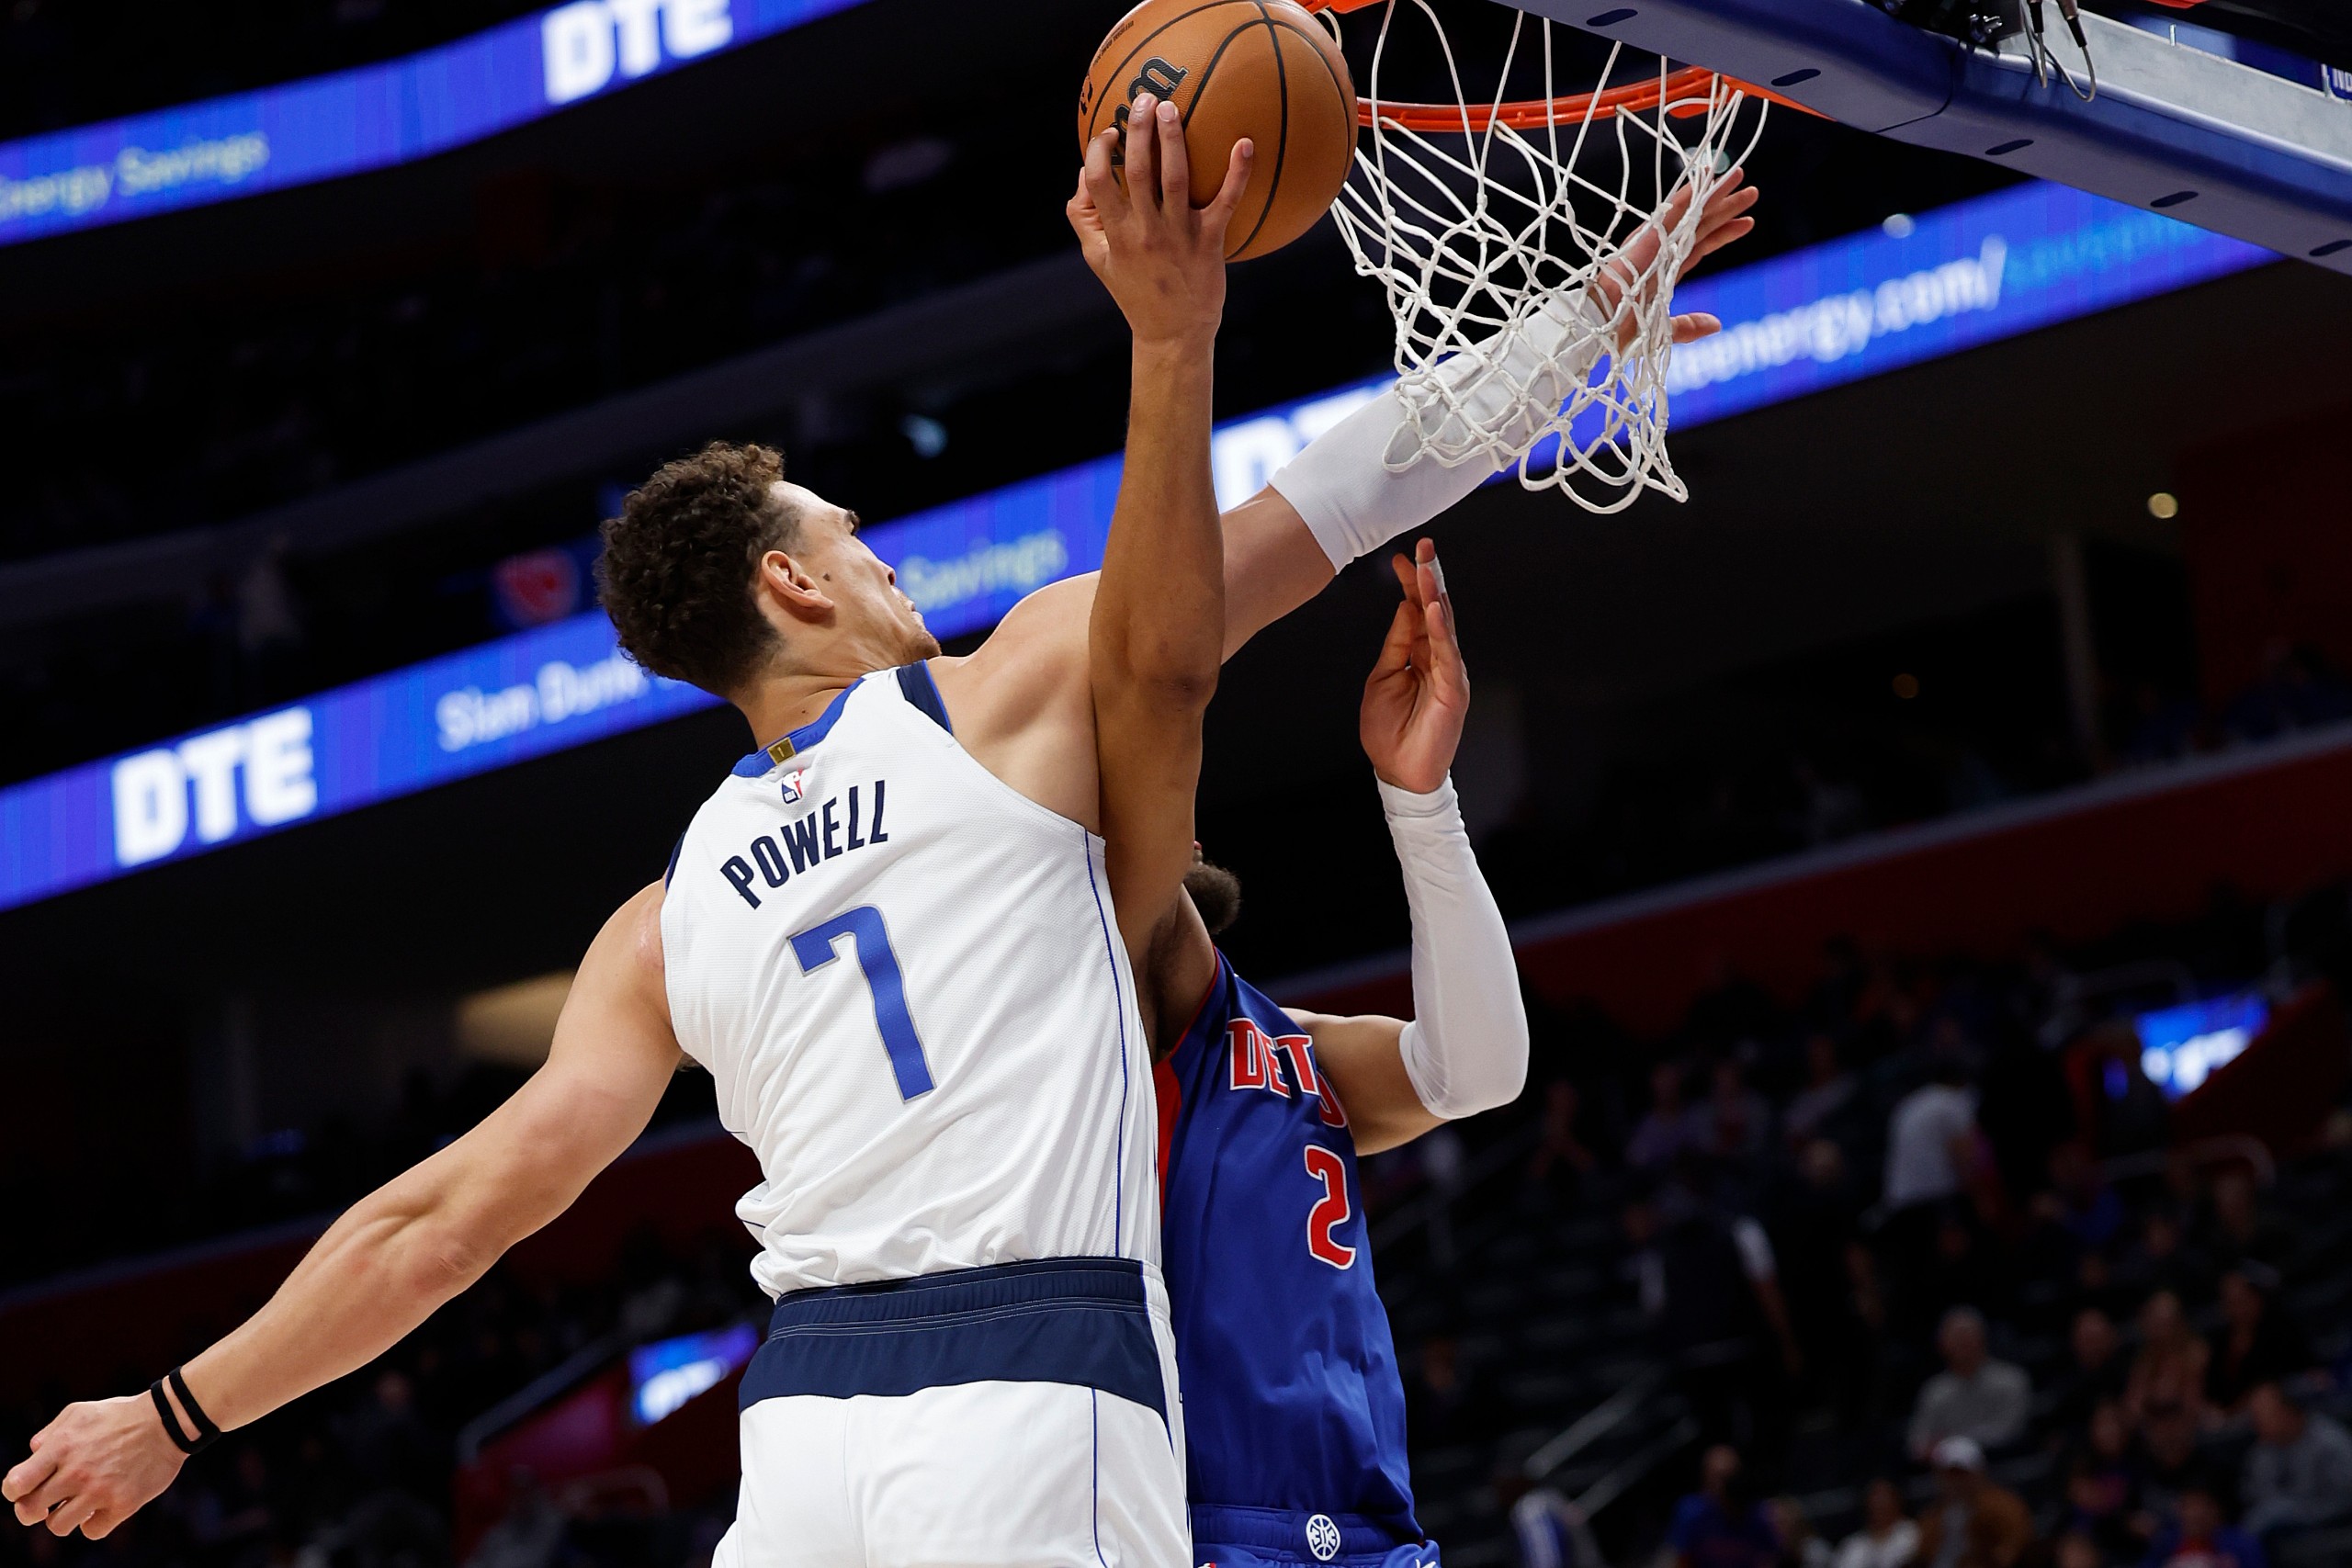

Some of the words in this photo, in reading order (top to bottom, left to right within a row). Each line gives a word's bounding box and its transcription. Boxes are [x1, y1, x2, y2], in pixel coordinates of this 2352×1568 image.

[540, 0, 733, 105] DTE
[117, 130, 270, 197] Savings
[111, 705, 318, 868] DTE
[720, 780, 889, 909] POWELL
[786, 903, 937, 1104] 7
[1304, 1145, 1356, 1271] 2
